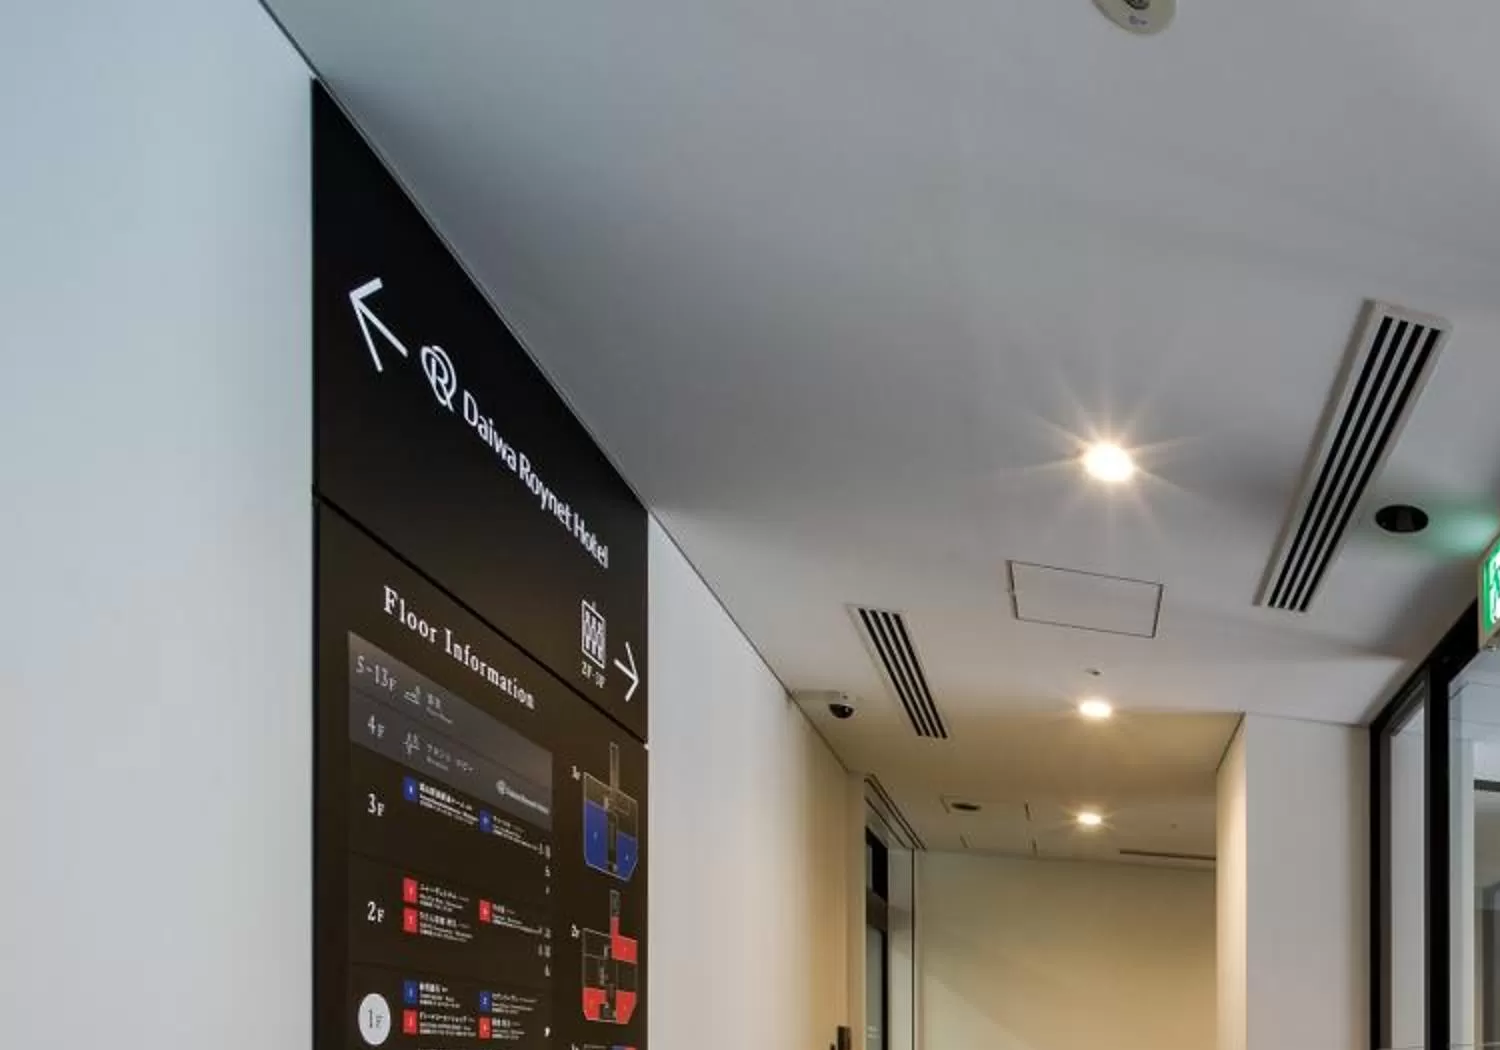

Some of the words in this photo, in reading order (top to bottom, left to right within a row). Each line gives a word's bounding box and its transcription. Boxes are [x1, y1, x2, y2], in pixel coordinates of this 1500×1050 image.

[463, 389, 517, 472] Daiwa
[519, 452, 572, 531] Roynet
[573, 512, 609, 569] Hotel
[383, 585, 437, 643] Floor
[444, 627, 535, 710] Information
[367, 793, 385, 817] 3F
[367, 901, 385, 923] 2F
